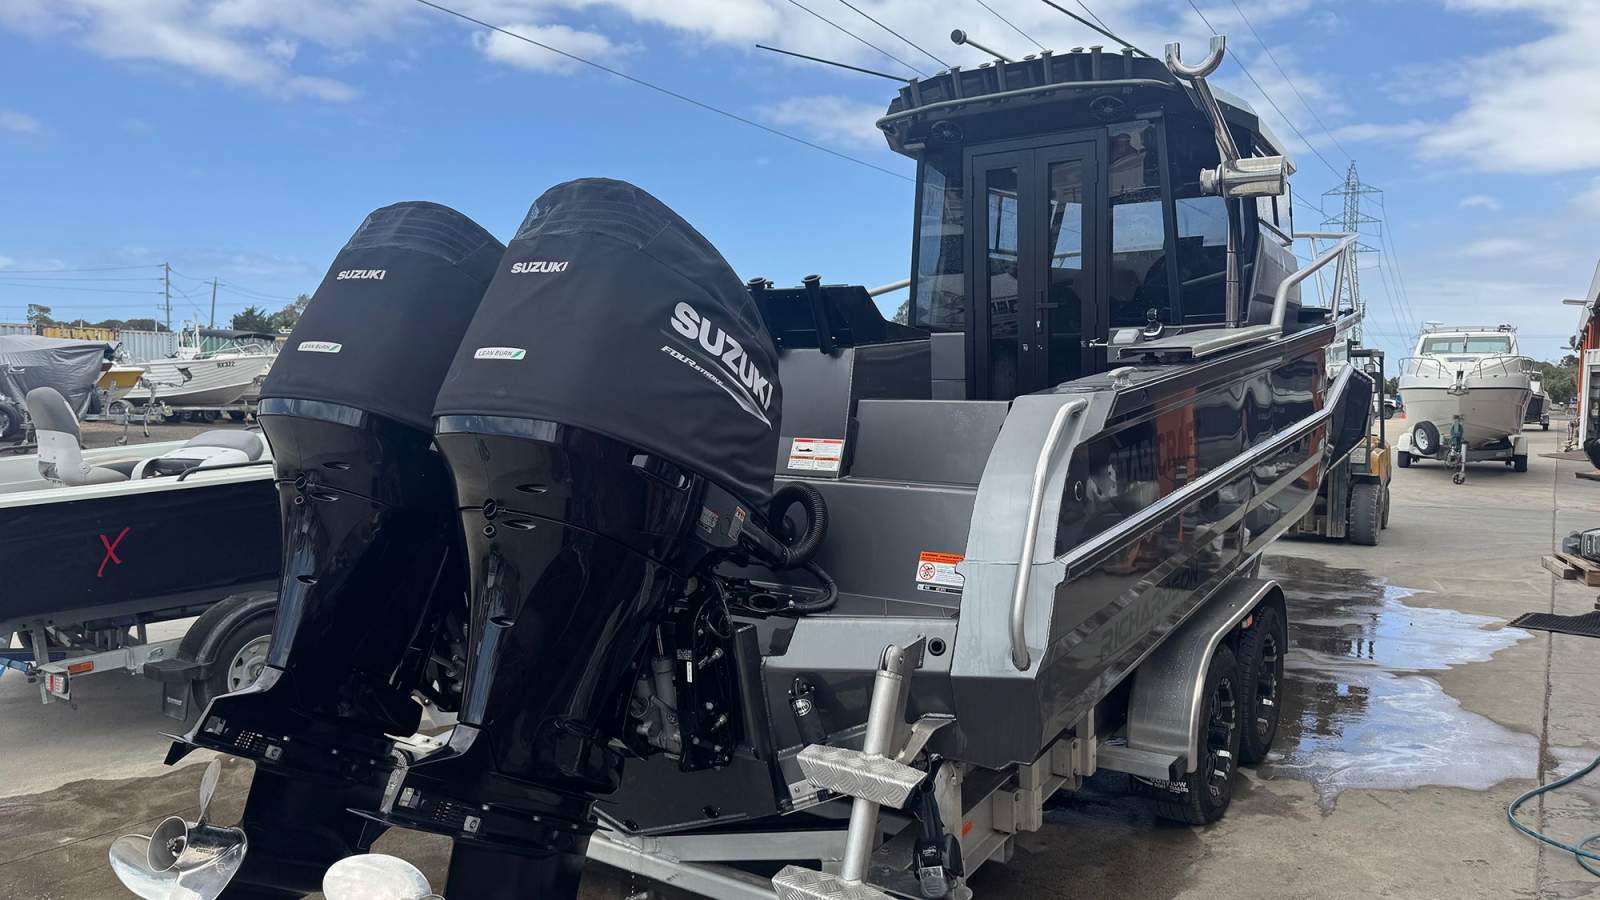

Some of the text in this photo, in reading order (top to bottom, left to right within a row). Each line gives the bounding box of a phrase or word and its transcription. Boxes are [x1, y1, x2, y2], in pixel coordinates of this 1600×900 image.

[336, 269, 387, 281] SUZUKI
[510, 261, 569, 274] SUZUKI
[670, 301, 774, 411] SUZUKI
[97, 526, 131, 577] X
